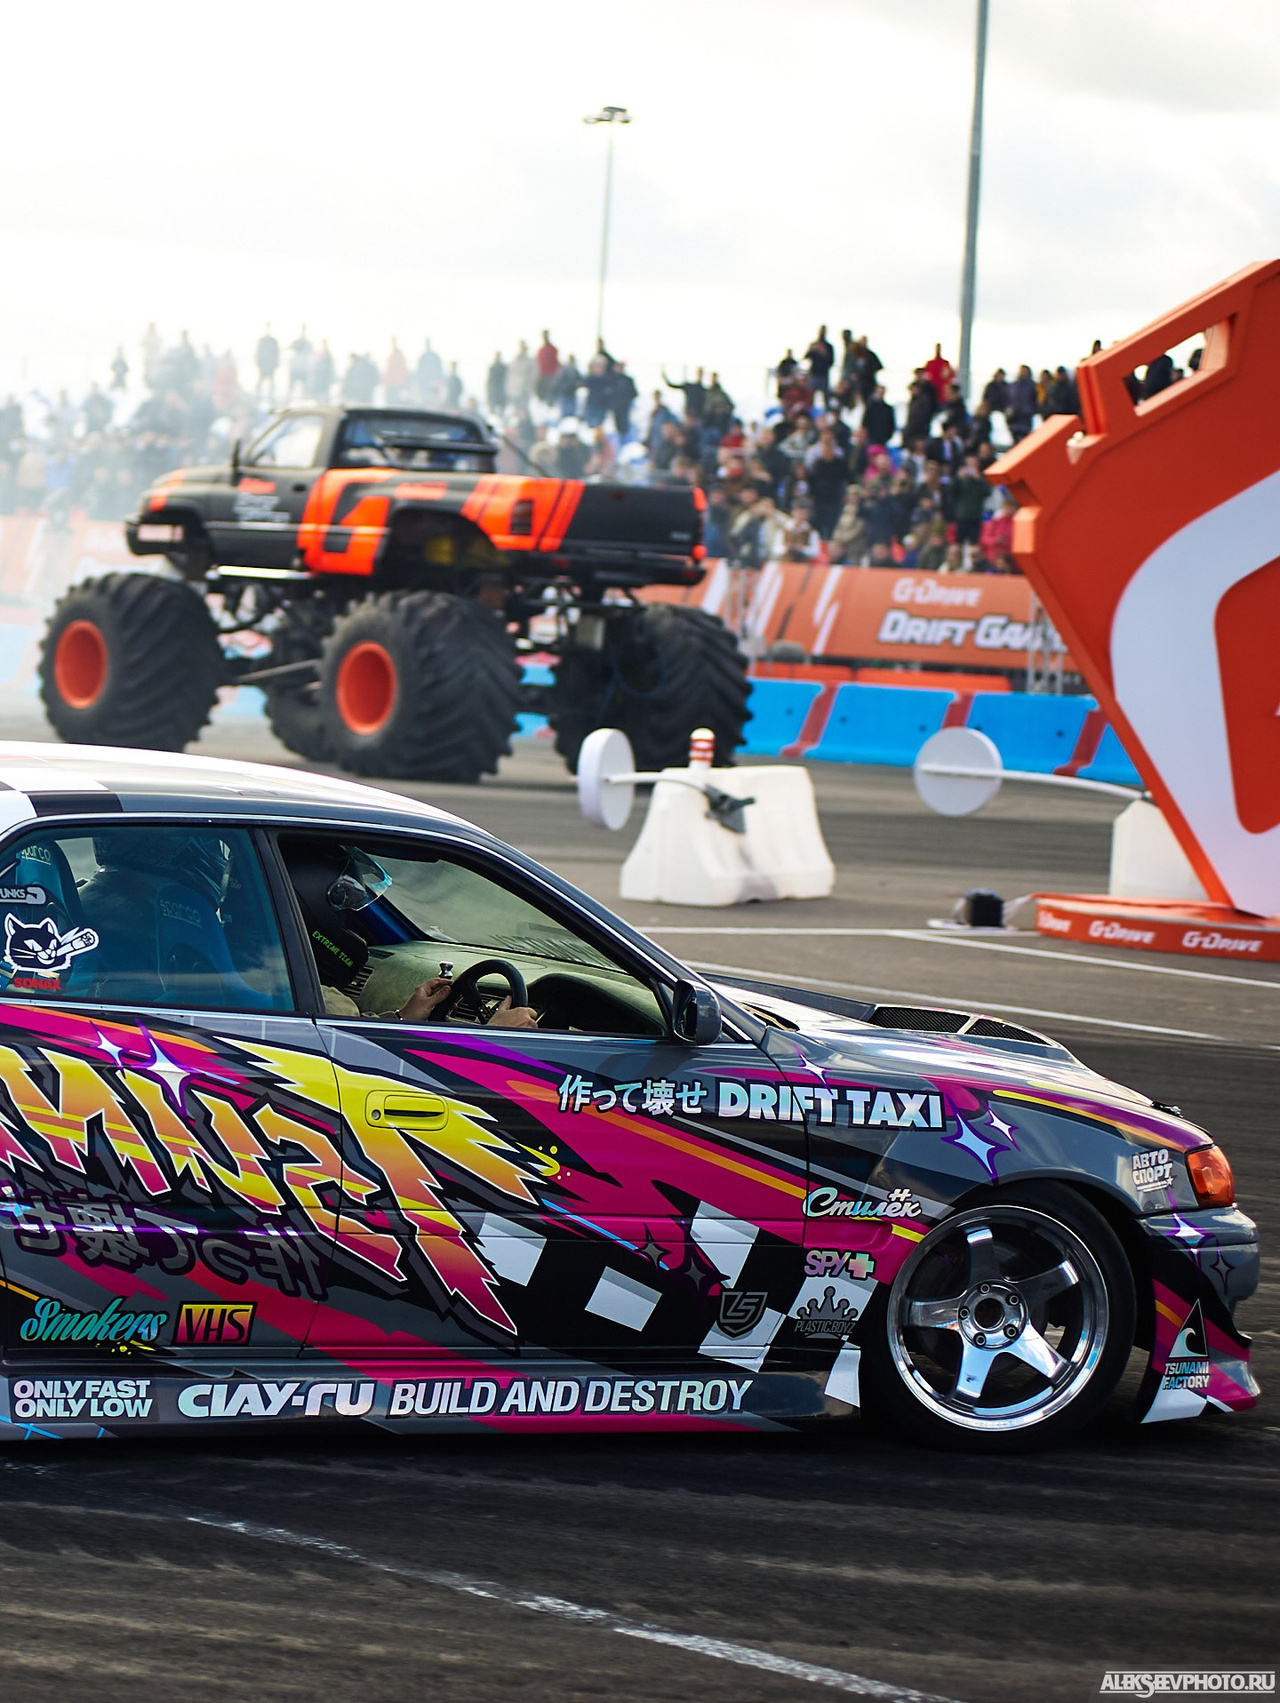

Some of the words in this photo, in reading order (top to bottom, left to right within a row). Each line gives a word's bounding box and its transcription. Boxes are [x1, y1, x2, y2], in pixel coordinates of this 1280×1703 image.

[877, 608, 975, 647] DRIFT
[13, 976, 61, 991] SONAX
[556, 1073, 708, 1116] 作って壊せ
[718, 1081, 840, 1125] DRIFT
[847, 1089, 943, 1129] TAXI
[1132, 1148, 1169, 1170] АВТО
[1132, 1163, 1173, 1185] СПОРТ
[19, 1297, 167, 1341] Smokers
[184, 1308, 250, 1343] VHS
[1164, 1361, 1210, 1375] TSUNAMI
[13, 1380, 80, 1399] ONLY
[85, 1379, 151, 1399] FAST
[1162, 1375, 1210, 1389] FACTORY
[14, 1398, 85, 1418] ONLY
[90, 1398, 153, 1418] LOW
[388, 1381, 498, 1416] BUILD
[500, 1381, 582, 1414] AND
[583, 1379, 753, 1413] DESTROY
